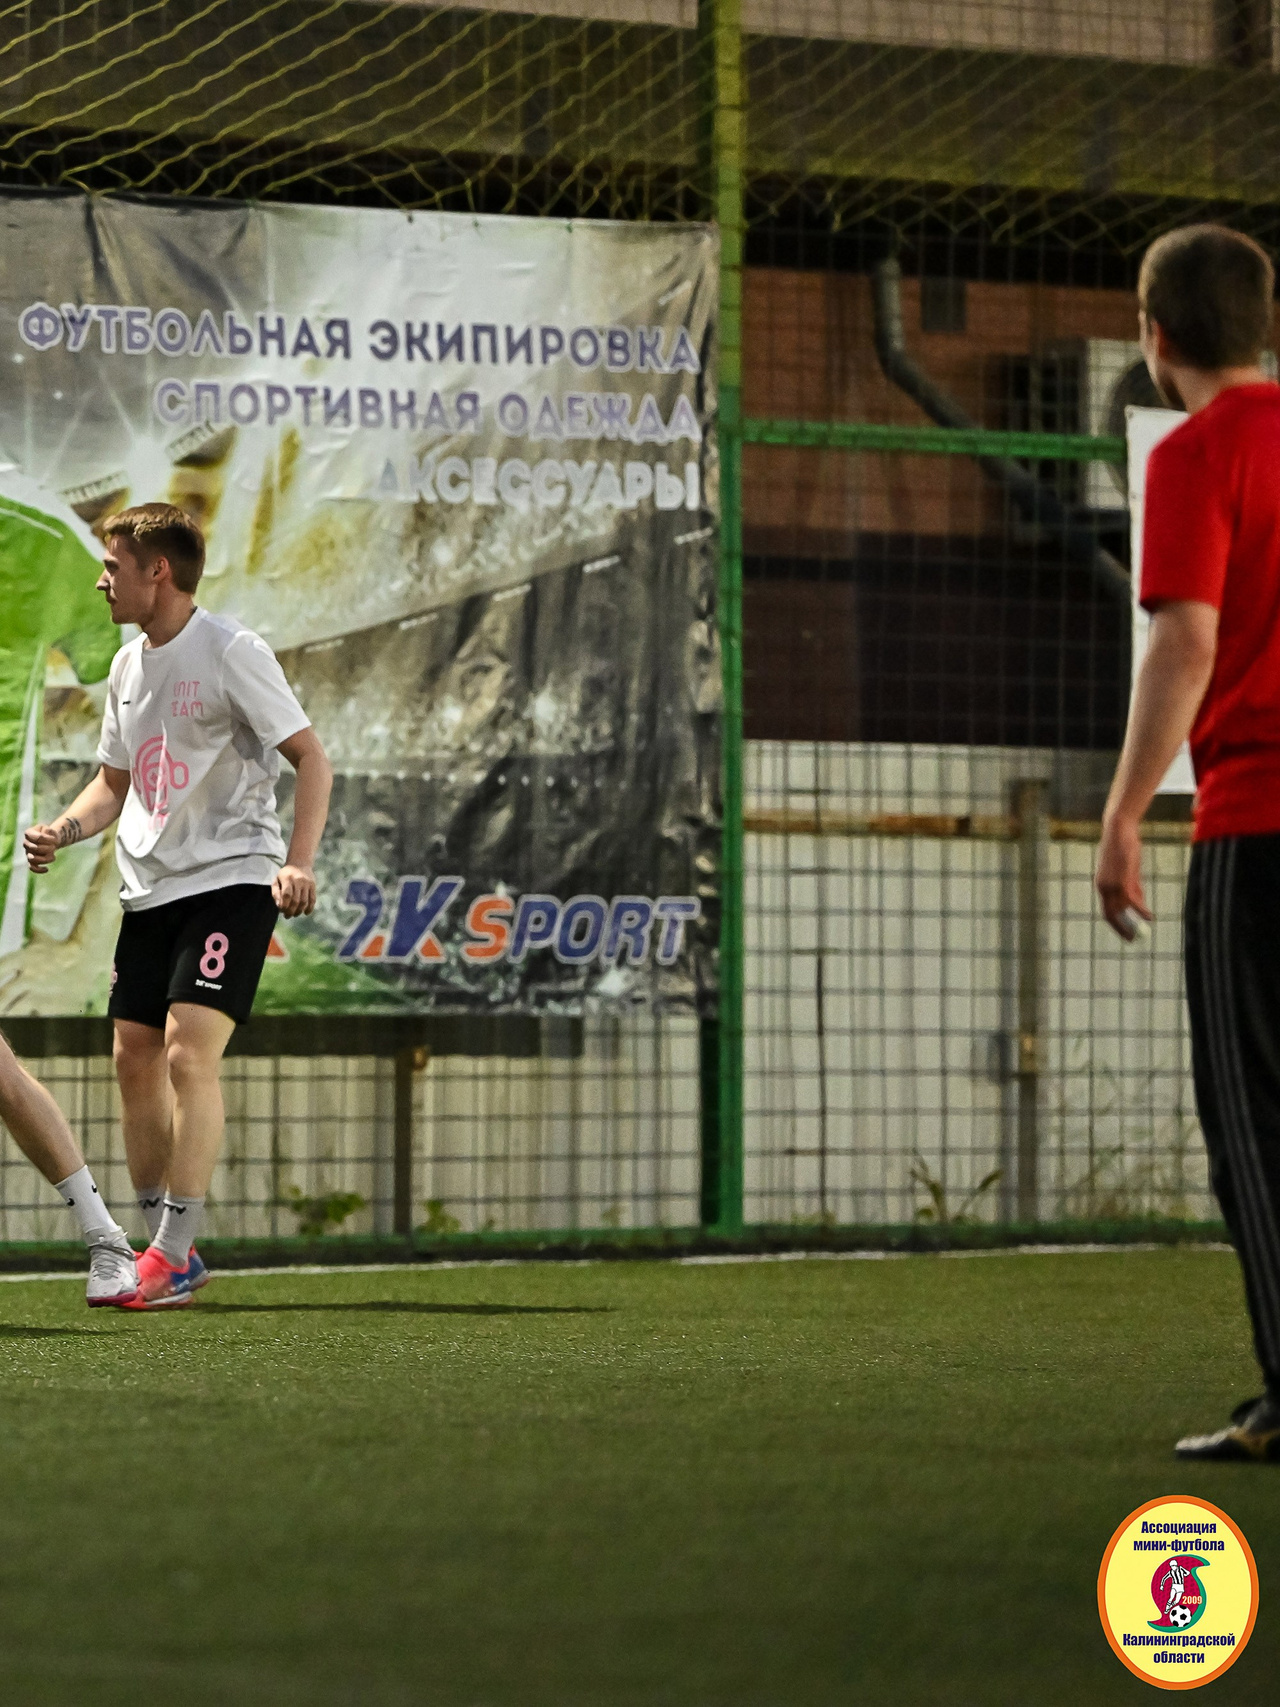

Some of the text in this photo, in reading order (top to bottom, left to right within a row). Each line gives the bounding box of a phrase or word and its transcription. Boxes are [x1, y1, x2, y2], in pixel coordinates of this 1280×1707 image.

[19, 303, 701, 374] ФУТБОЛЬНАЯ ЭКИПИРОВКА
[155, 378, 702, 443] СПОРТИВНАЯ ОДЕЖДА
[376, 454, 701, 511] АКСЕССУАРЫ
[199, 932, 229, 979] 8
[463, 894, 700, 966] SPORT
